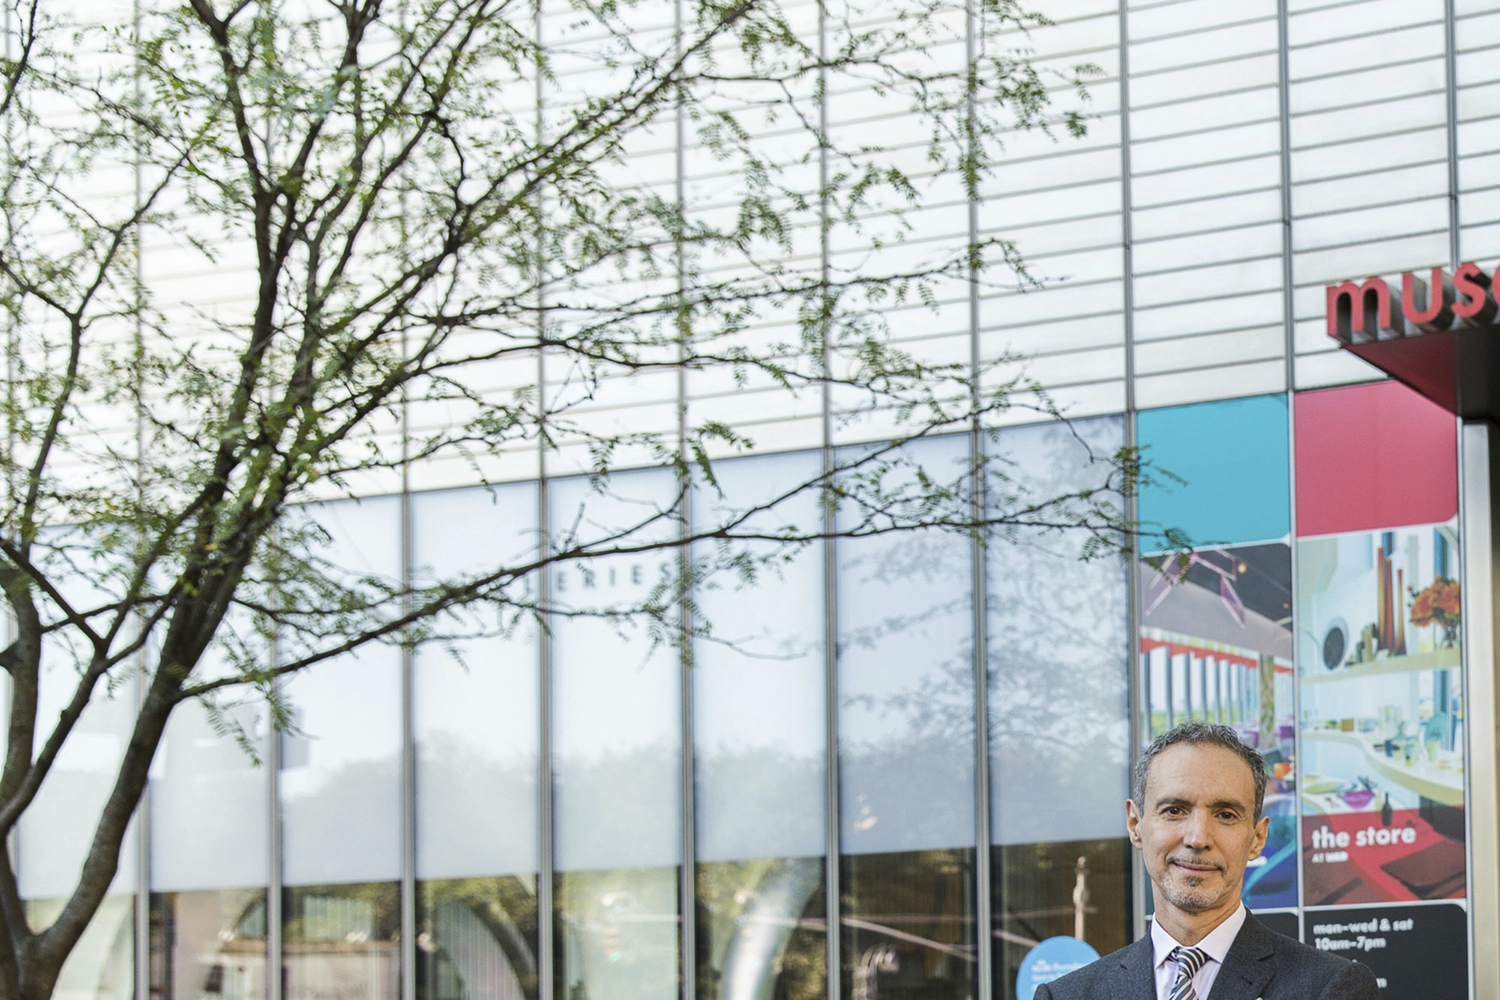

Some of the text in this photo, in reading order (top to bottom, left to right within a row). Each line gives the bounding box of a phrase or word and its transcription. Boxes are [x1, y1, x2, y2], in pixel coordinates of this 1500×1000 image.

[1312, 825, 1417, 849] the store
[1379, 919, 1391, 932] &
[1393, 918, 1414, 931] sat
